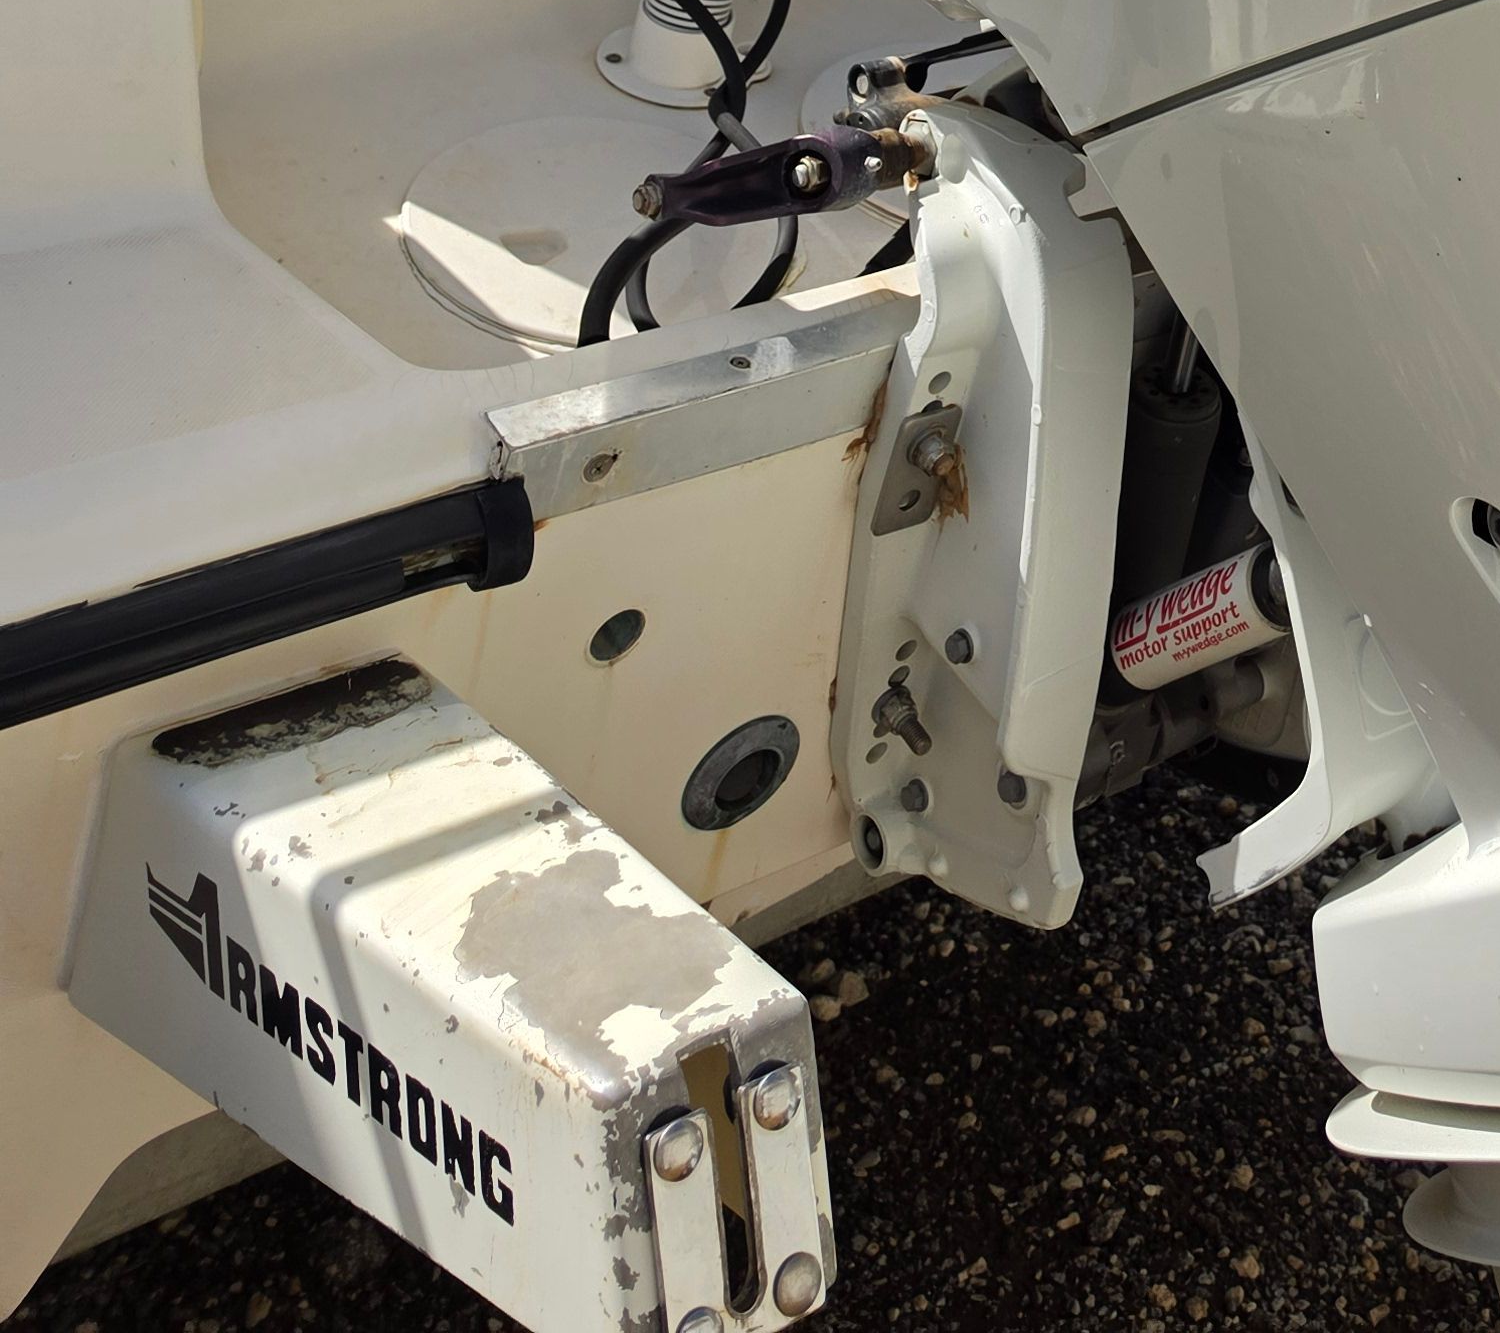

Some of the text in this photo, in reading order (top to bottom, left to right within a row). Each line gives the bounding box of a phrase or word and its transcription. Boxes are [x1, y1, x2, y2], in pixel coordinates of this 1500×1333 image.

[1157, 561, 1238, 633] wedge
[1119, 601, 1240, 670] motor support
[146, 863, 515, 1226] ARMSTRONG
